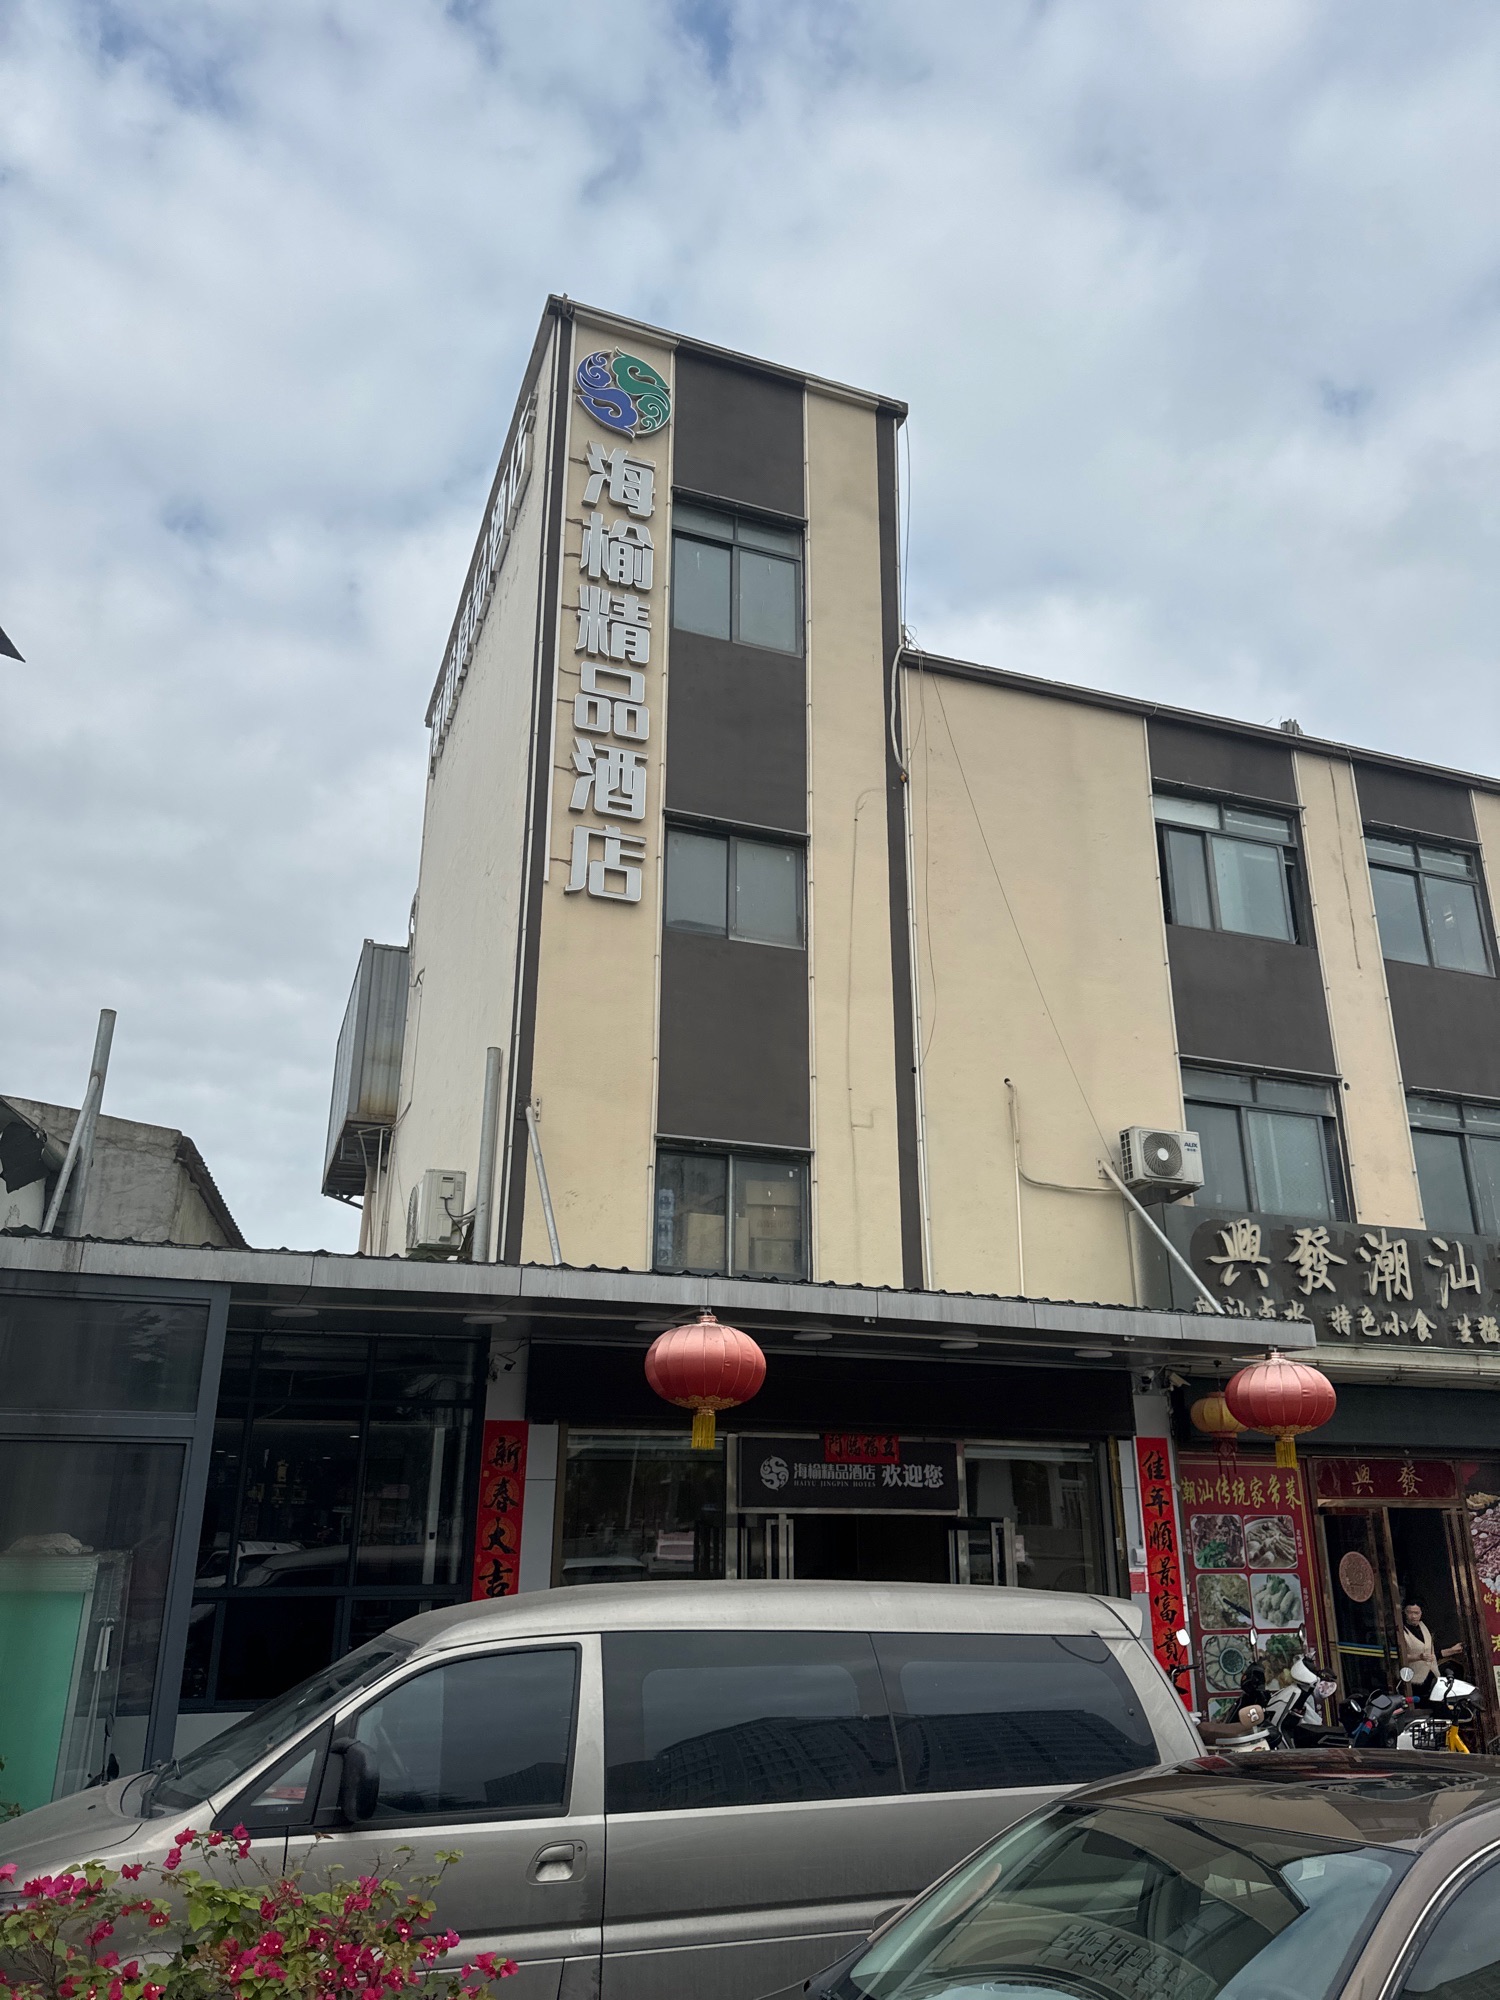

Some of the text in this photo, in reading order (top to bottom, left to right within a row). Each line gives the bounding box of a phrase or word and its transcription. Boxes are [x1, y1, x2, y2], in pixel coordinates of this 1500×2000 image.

[564, 440, 656, 903] 海榆精品酒店
[1205, 1218, 1482, 1310] 興發潮汕
[1329, 1304, 1437, 1343] 特色小食
[793, 1463, 944, 1488] 海榆精品酒店 欢迎您
[793, 1480, 817, 1488] HAIYU
[820, 1480, 849, 1488] JINGPIN
[1352, 1464, 1423, 1496] 興發
[478, 1436, 521, 1597] 新春大吉
